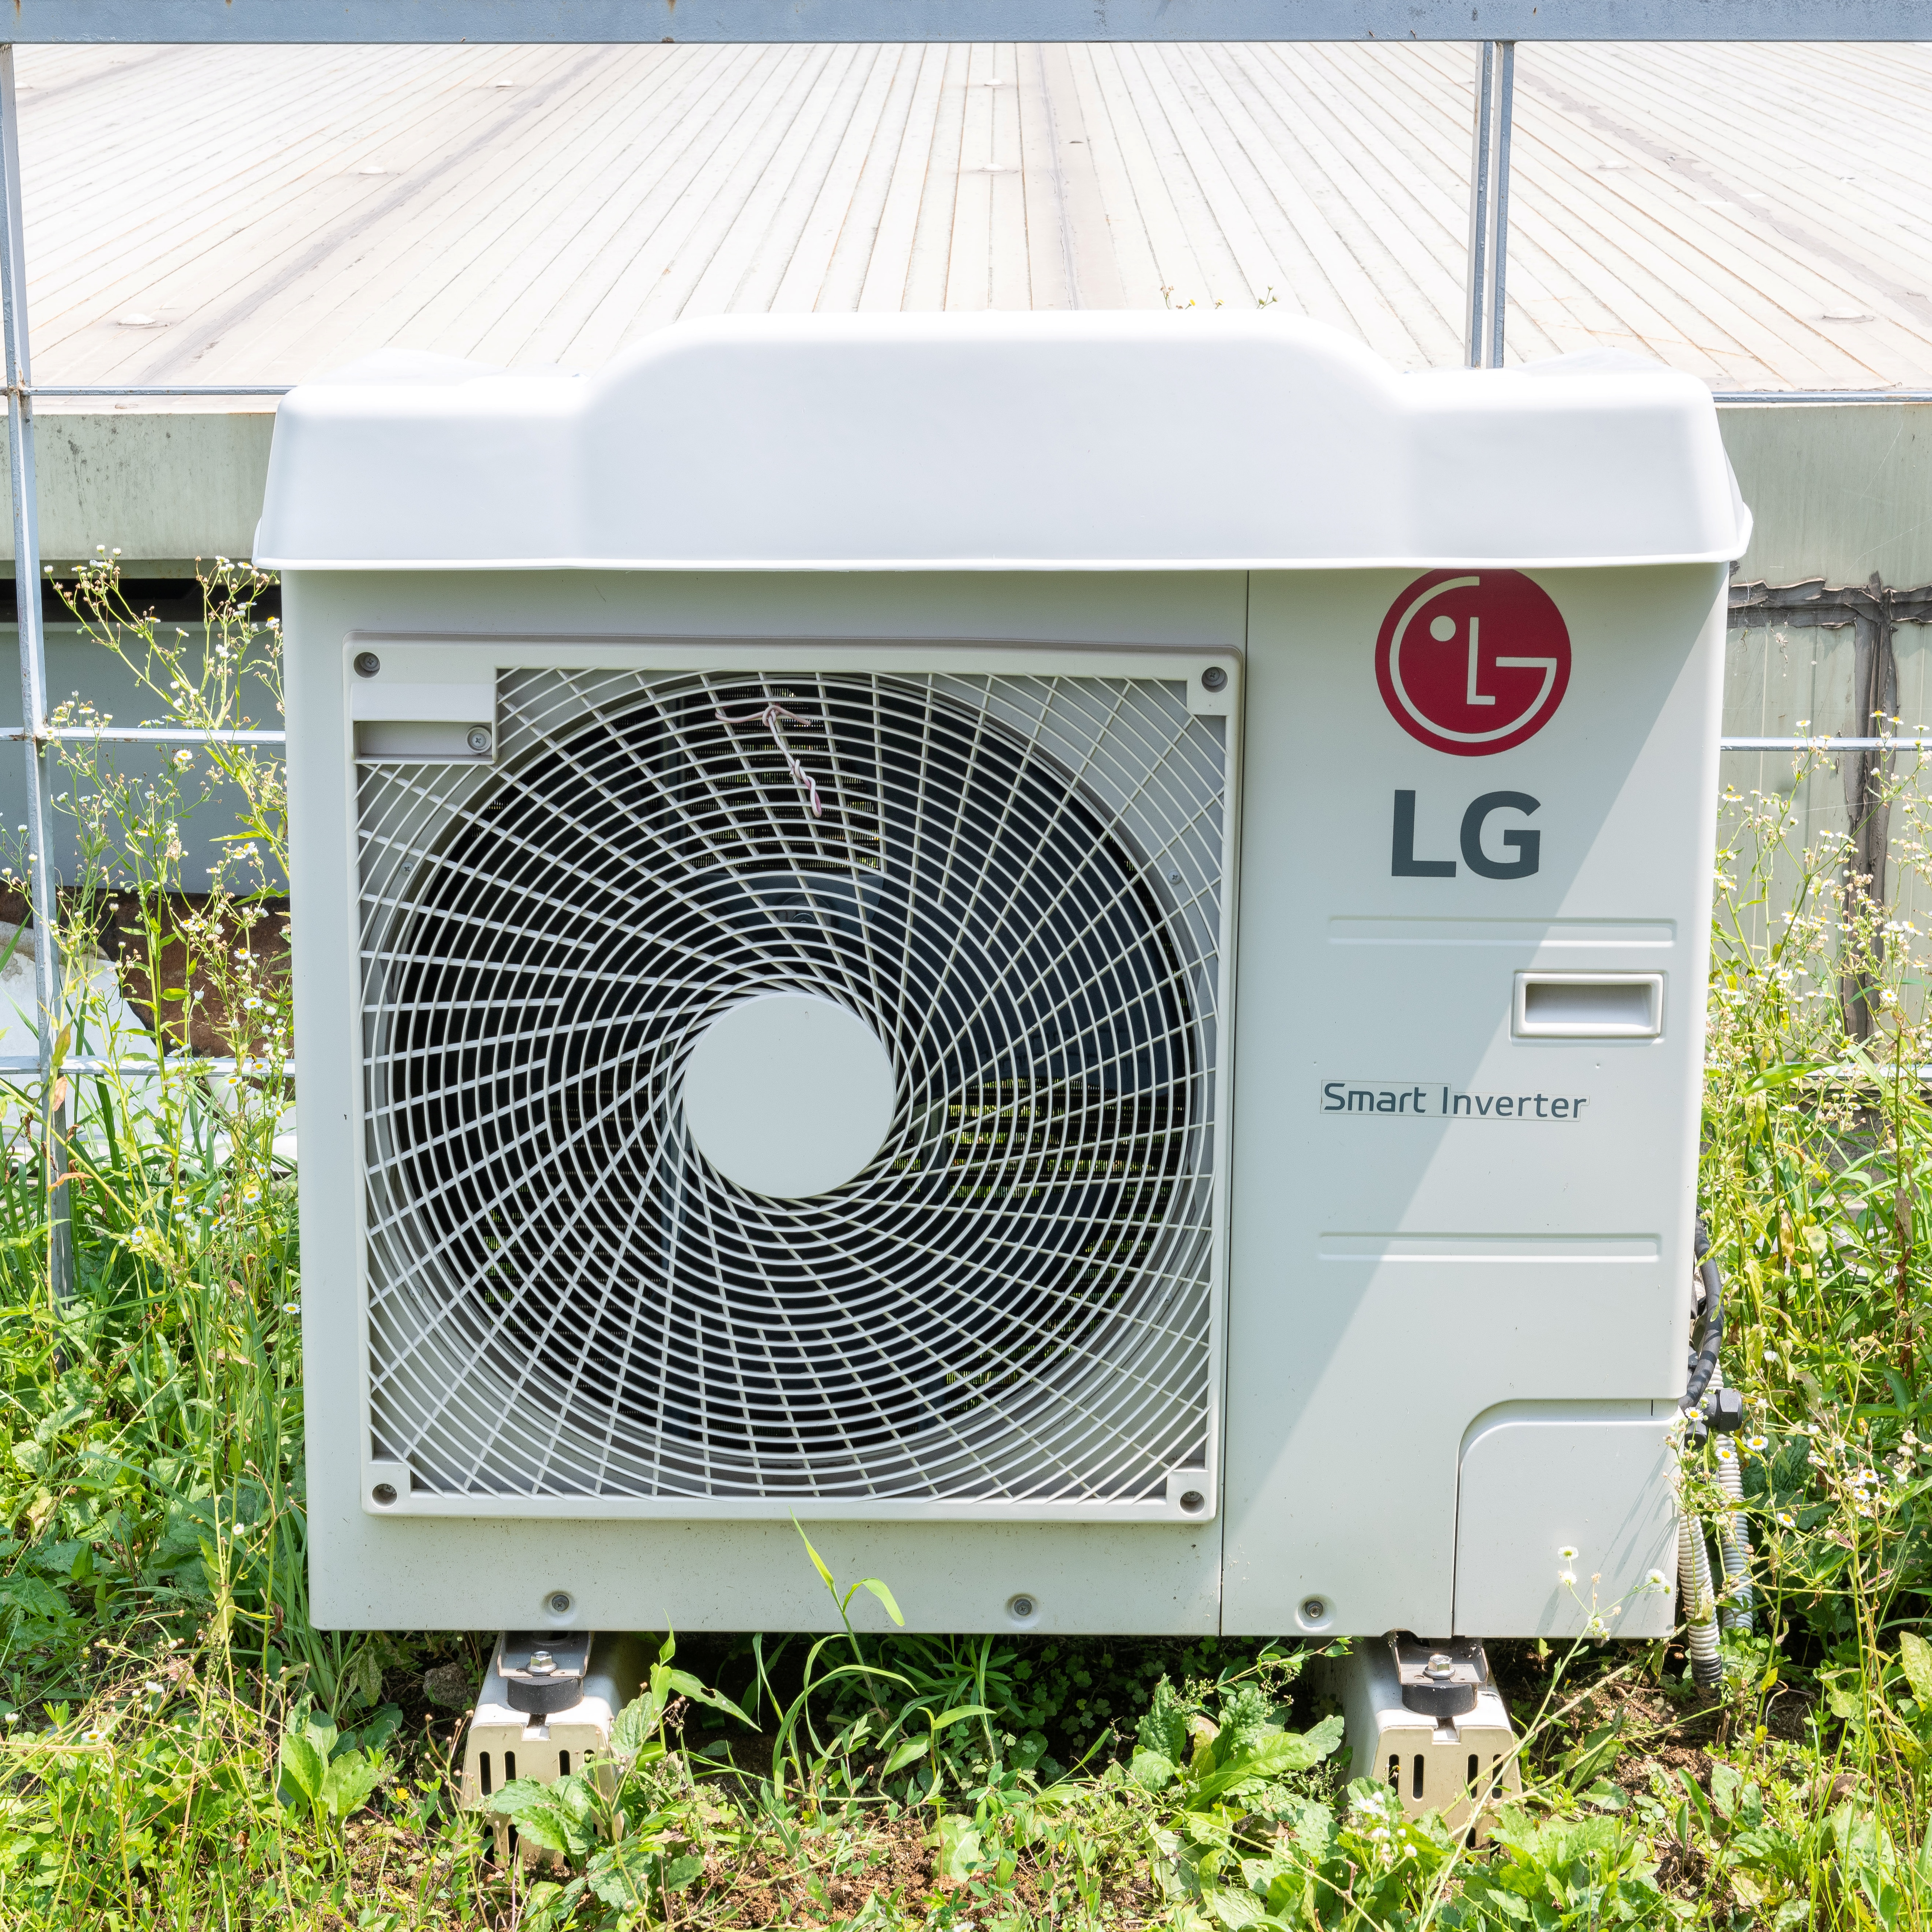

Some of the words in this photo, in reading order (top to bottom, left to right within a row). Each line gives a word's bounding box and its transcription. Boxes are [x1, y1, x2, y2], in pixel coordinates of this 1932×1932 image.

[1390, 789, 1542, 880] LG
[1323, 1082, 1427, 1113] Smart
[1441, 1086, 1588, 1119] Inverter
